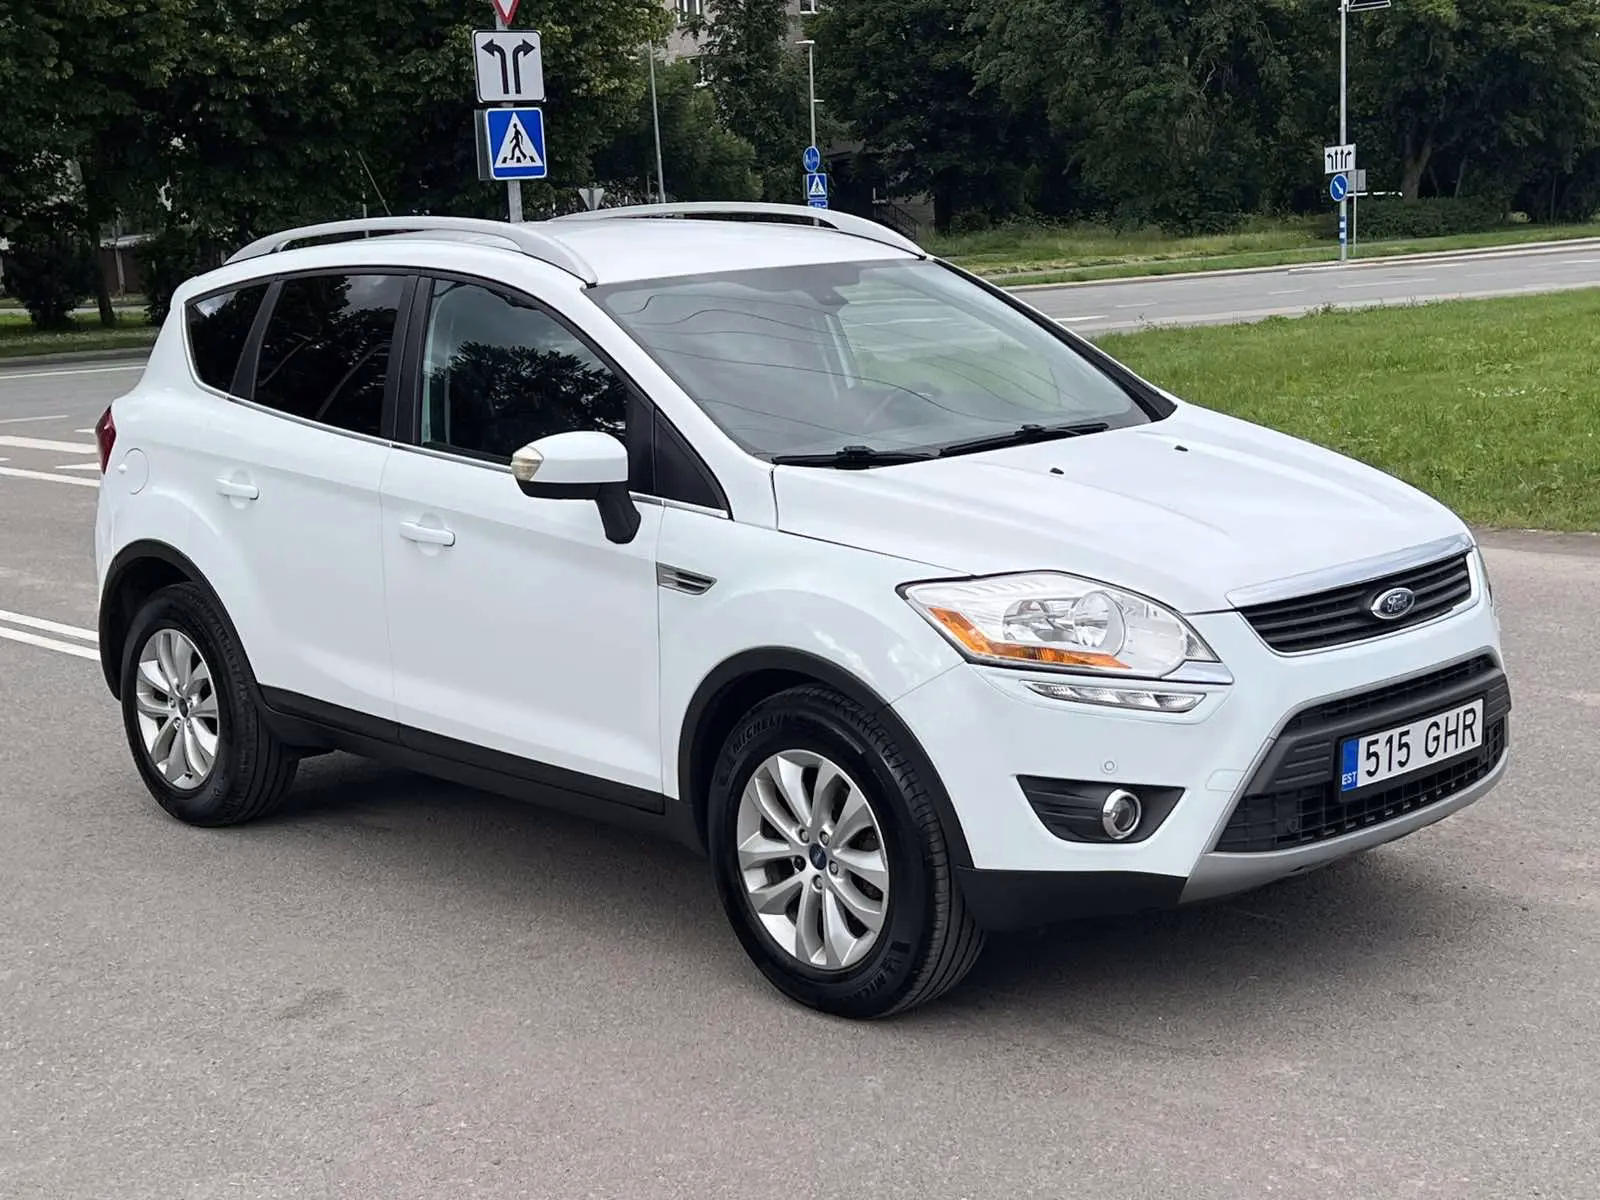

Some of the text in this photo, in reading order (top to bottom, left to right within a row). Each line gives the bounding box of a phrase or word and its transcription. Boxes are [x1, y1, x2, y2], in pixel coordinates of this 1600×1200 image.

[1341, 707, 1477, 785] EST 515 GHR
